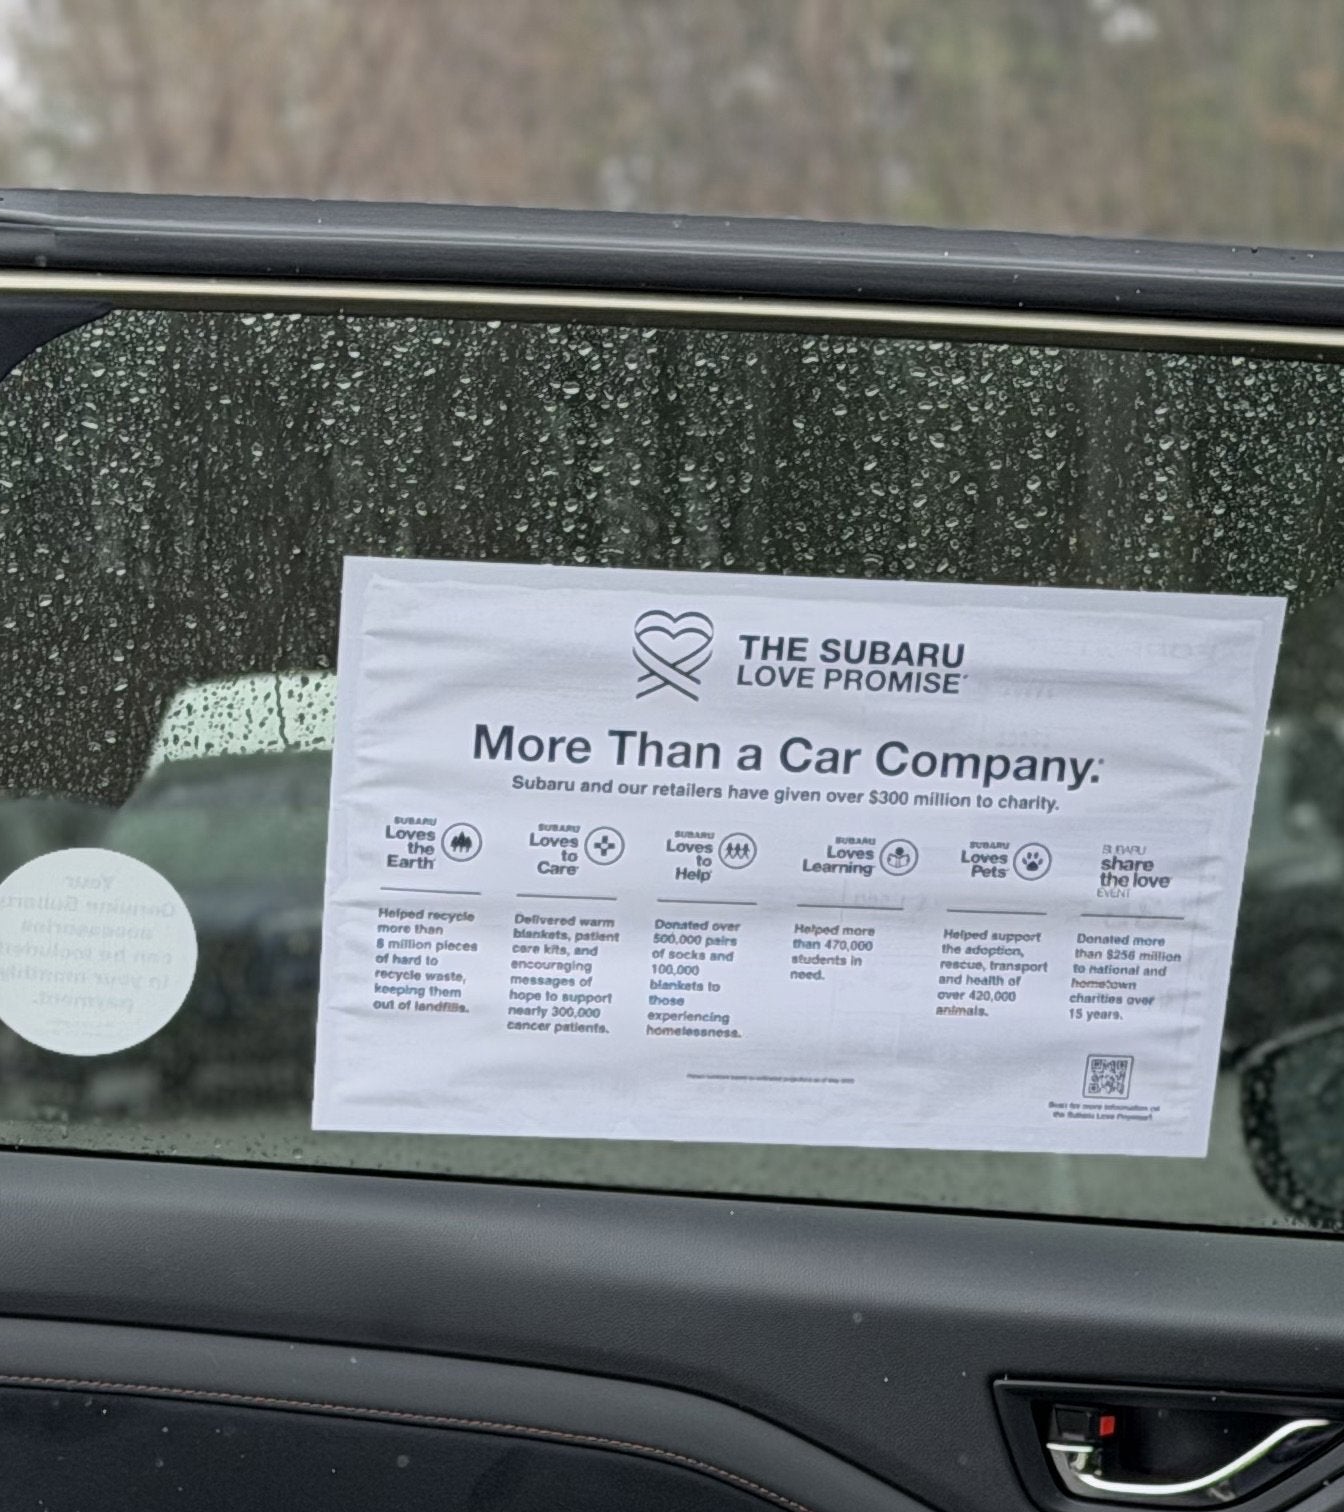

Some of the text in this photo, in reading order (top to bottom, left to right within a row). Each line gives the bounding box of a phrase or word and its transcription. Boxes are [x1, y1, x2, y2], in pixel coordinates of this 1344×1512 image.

[738, 634, 965, 668] THE SUBARU
[737, 665, 960, 694] LOVE PROMISE
[472, 723, 1102, 791] More Than a Car Company.
[511, 775, 1061, 814] Subaru and our retailers have given over $300 million to charity.
[394, 816, 437, 826] SUBARU
[385, 825, 436, 841] Loves
[538, 823, 580, 833] SUBARU
[529, 833, 579, 848] Loves
[674, 830, 715, 840] SUBARU
[835, 836, 876, 845] SUBARU
[407, 842, 435, 855] the
[666, 839, 713, 853] Loves
[969, 841, 1010, 850] SUBARU
[561, 850, 578, 862] to
[827, 845, 874, 860] Loves
[961, 850, 1008, 864] Loves
[387, 854, 434, 870] Earth
[696, 855, 712, 867] to
[1101, 856, 1154, 872] share
[537, 861, 577, 876] Care
[802, 859, 873, 877] Learning
[971, 865, 1006, 878] Pets
[675, 867, 711, 883] Help
[1100, 872, 1171, 888] the love
[1097, 888, 1131, 898] EVENT
[378, 908, 475, 923] Helped recycle
[514, 914, 615, 927] Delivered warm
[377, 925, 444, 935] more than
[654, 918, 741, 932] Donated over
[794, 923, 875, 937] Helped more
[513, 928, 620, 943] blankets, patient
[653, 933, 737, 948] 500,000 pairs
[943, 929, 1042, 943] Helped support
[1077, 933, 1165, 946] Donated more
[388, 939, 432, 950] million
[435, 941, 478, 953] pieces
[511, 943, 598, 957] care kits, and
[792, 939, 873, 953] than 470,000
[942, 944, 1025, 958] the adoption,
[375, 953, 439, 966] of hard to
[652, 949, 734, 962] of socks and
[791, 954, 862, 967] students in
[1074, 949, 1103, 959] than
[1138, 951, 1182, 962] million
[510, 959, 592, 973] encouraging
[651, 964, 700, 976] 100,000
[940, 960, 1048, 974] rescue, transport
[1073, 963, 1167, 977] to national and
[374, 969, 466, 984] recycle waste,
[510, 974, 593, 988] messages of
[790, 970, 826, 980] need.
[939, 974, 1022, 986] and health of
[374, 983, 462, 998] keeping them
[650, 980, 721, 992] blankets to
[1071, 978, 1137, 990] hometown
[509, 988, 613, 1005] hope to support
[649, 995, 685, 1006] those
[937, 990, 1016, 1003] over 420,000
[1069, 993, 1154, 1006] charities over
[373, 1000, 470, 1013] out of landfills.
[508, 1006, 601, 1019] nearly 300,000
[936, 1005, 989, 1017] animals.
[647, 1011, 730, 1024] experiencing
[1069, 1008, 1123, 1021] 15 years.
[507, 1021, 610, 1034] cancer patients.
[646, 1025, 742, 1038] homelessness.
